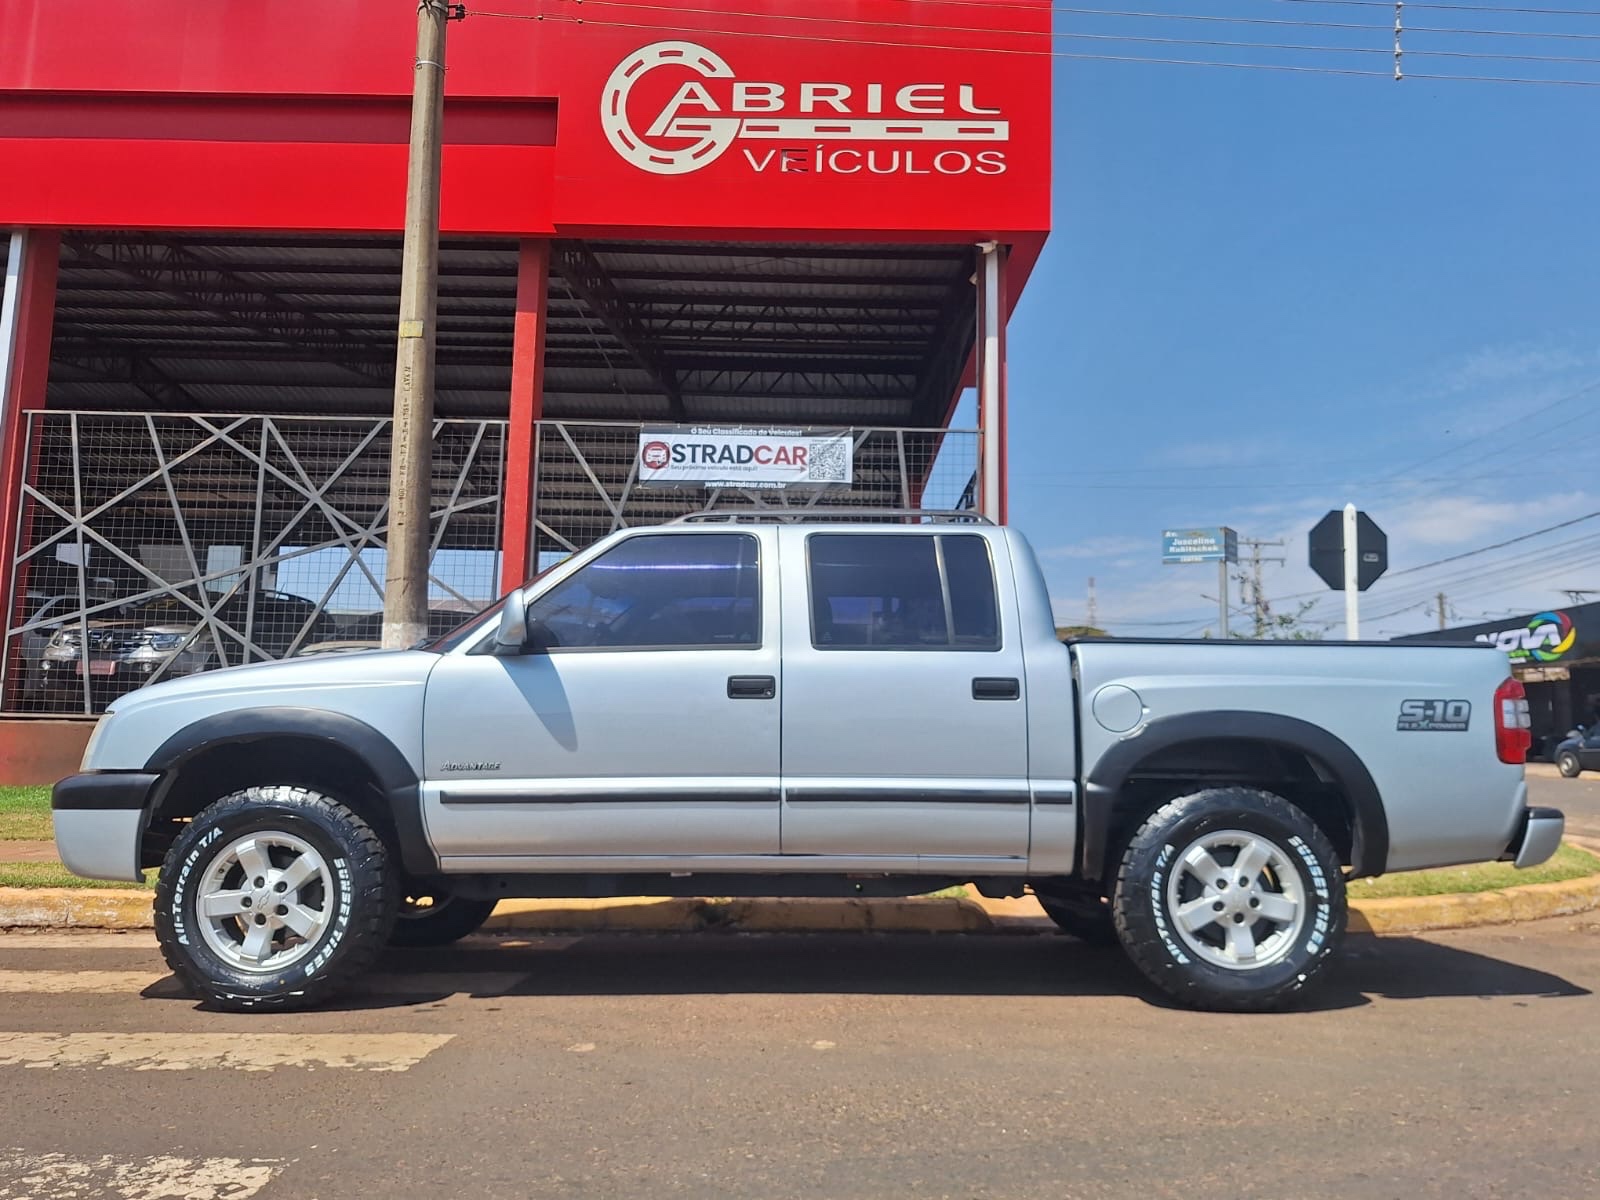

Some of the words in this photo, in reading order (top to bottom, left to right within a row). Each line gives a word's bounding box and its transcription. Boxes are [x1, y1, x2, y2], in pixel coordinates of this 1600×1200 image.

[743, 144, 1007, 174] VEÍCULOS
[198, 826, 224, 849] T/A
[333, 857, 353, 928] SUNSET
[303, 929, 344, 978] TIRES
